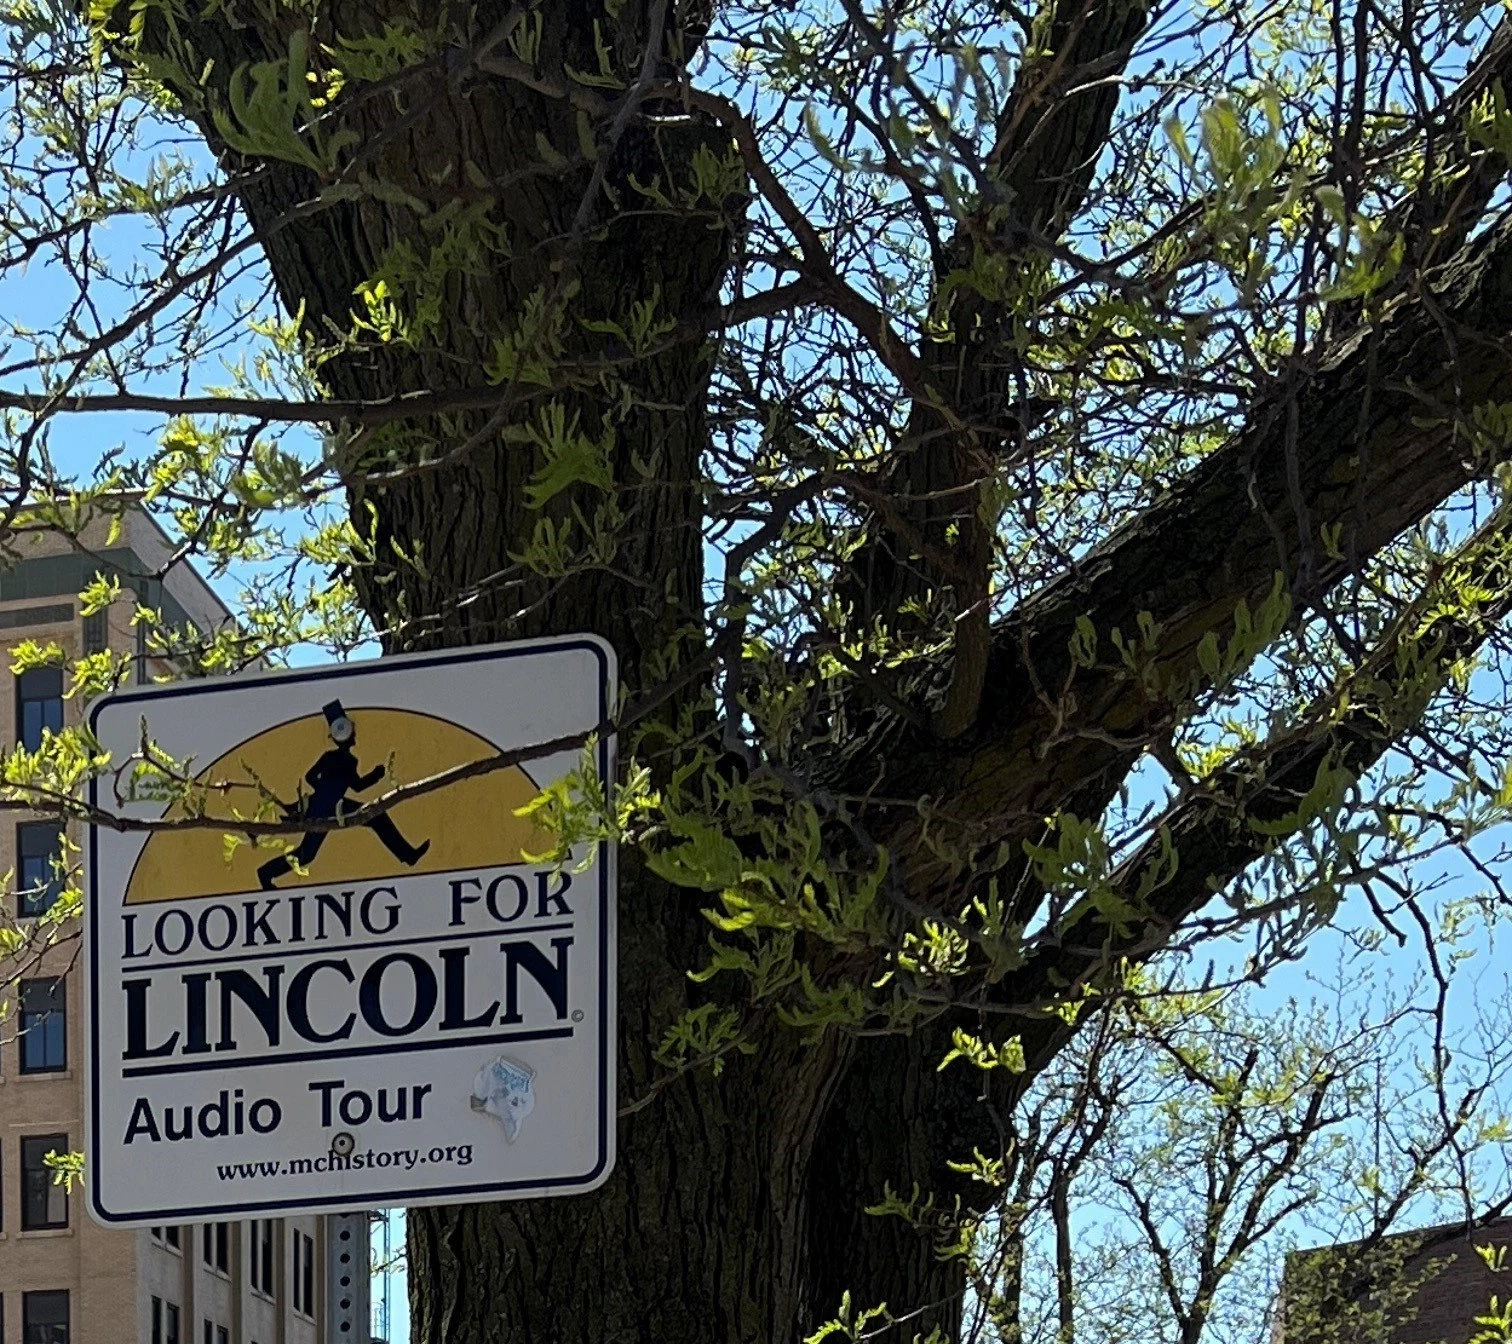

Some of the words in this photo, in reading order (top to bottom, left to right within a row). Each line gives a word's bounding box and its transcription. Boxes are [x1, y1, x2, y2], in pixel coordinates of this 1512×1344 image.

[121, 886, 402, 960] LOOKING
[449, 870, 574, 927] FOR
[122, 936, 574, 1061] LINCOLN
[124, 1090, 281, 1144] Audio
[309, 1079, 432, 1127] Tour
[216, 1142, 473, 1182] www.mchistory.org
